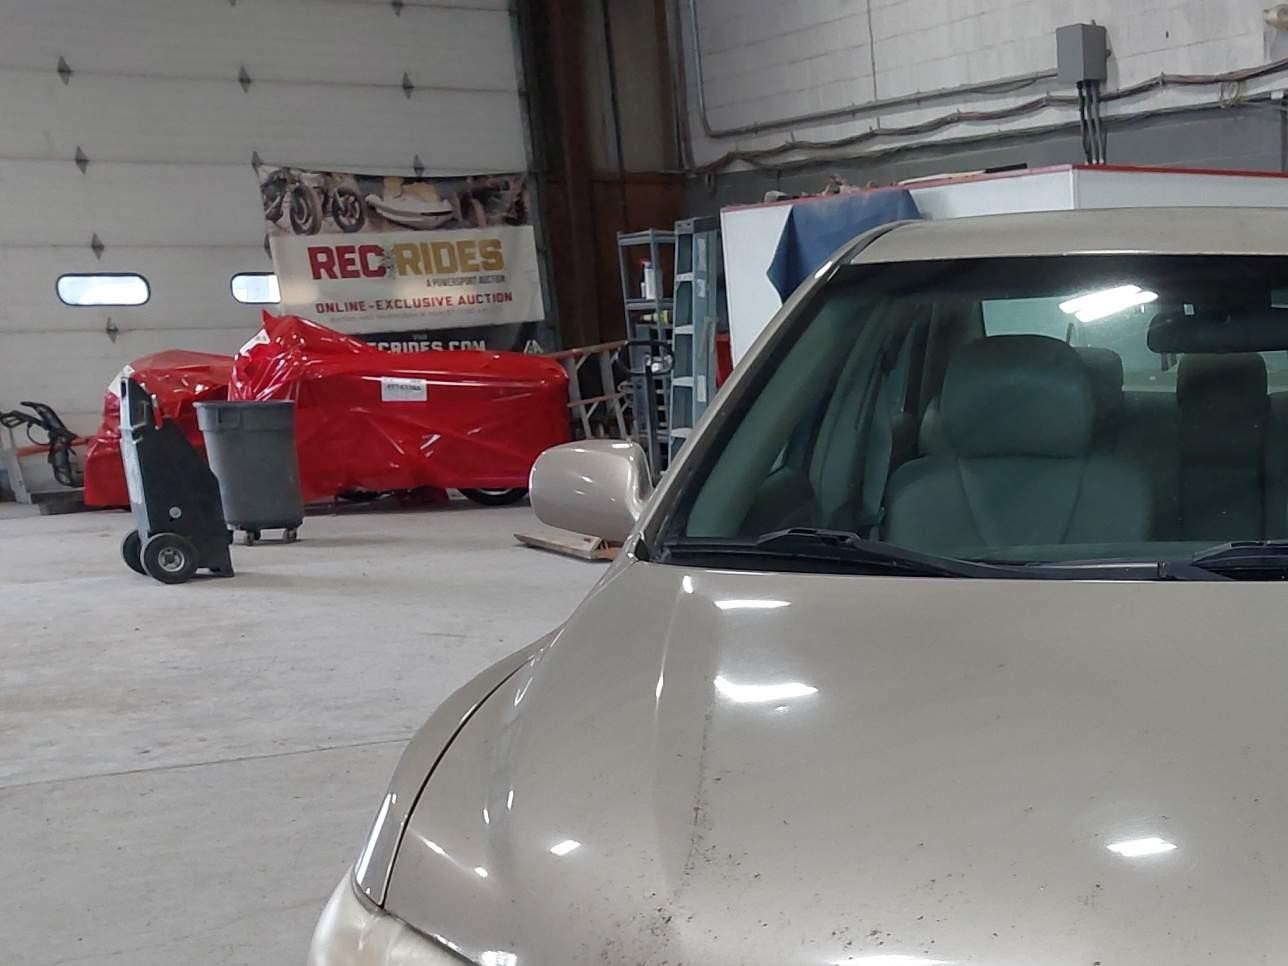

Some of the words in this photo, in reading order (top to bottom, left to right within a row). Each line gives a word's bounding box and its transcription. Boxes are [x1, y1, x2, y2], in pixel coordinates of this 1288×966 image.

[307, 244, 387, 280] REC
[391, 239, 505, 276] RIDES
[315, 295, 453, 314] ONLINE-EXCLUSIVE
[458, 291, 513, 306] AUCTION
